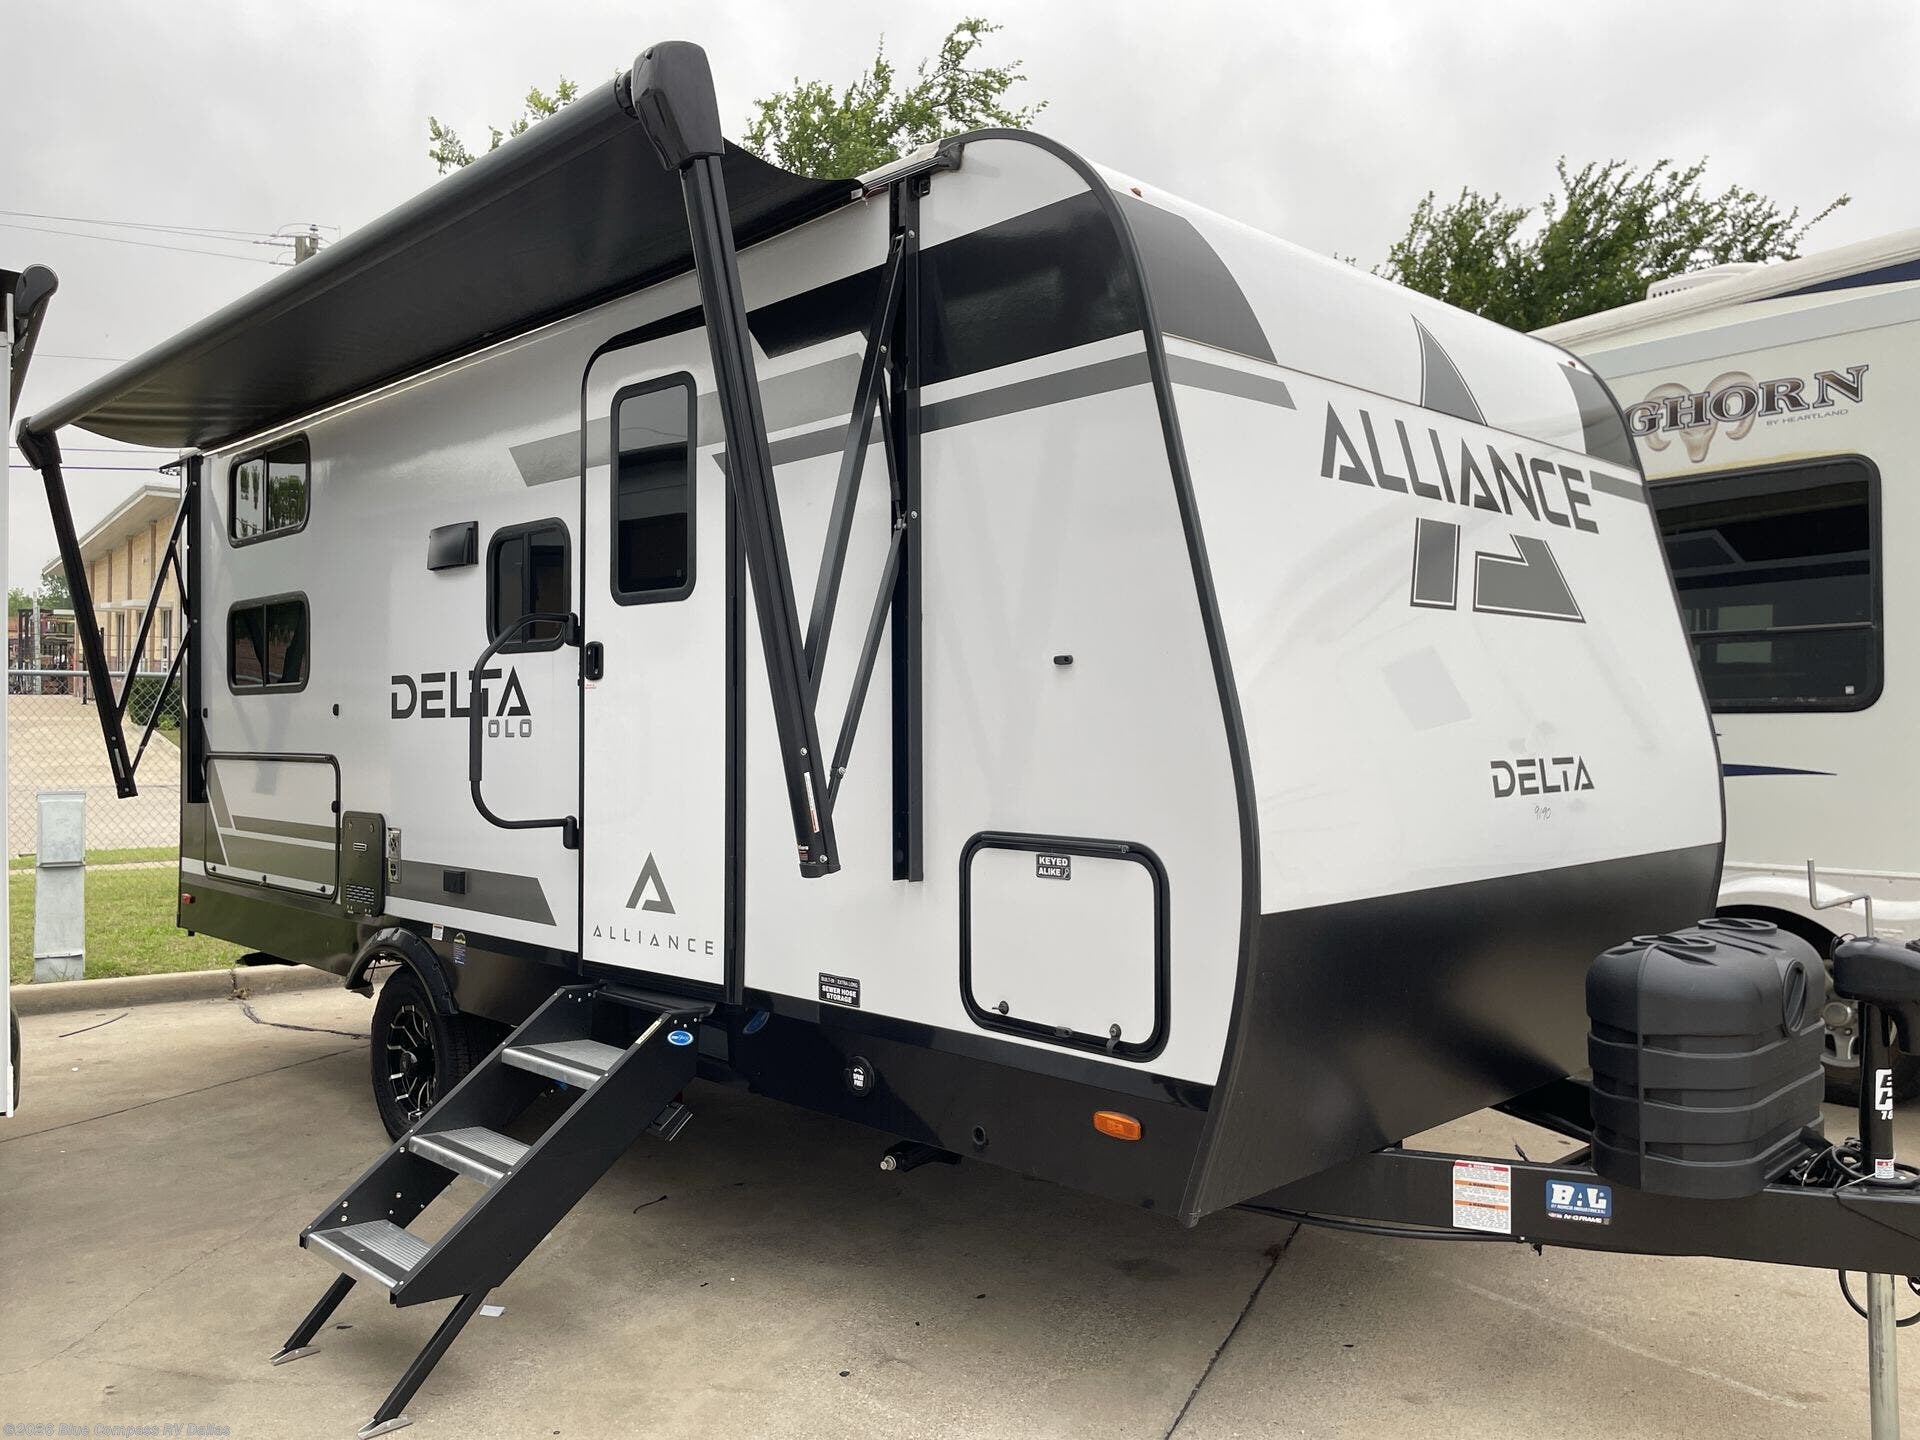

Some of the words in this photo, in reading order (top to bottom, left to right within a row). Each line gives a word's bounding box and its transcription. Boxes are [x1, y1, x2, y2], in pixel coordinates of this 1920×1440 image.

[1766, 418, 1779, 427] BY
[1782, 408, 1849, 424] HEARTLAND
[1320, 400, 1600, 535] ALLIANCE
[391, 666, 531, 719] DELTA
[487, 719, 532, 738] OLO
[1490, 756, 1595, 798] DELTA
[1039, 856, 1069, 867] KEYED
[1038, 867, 1061, 876] ALIKE
[592, 924, 714, 955] ALLIANCE
[821, 984, 841, 995] SEWER
[841, 988, 857, 998] HOSE
[826, 992, 853, 1004] STORAGE
[1551, 1183, 1607, 1209] BAL
